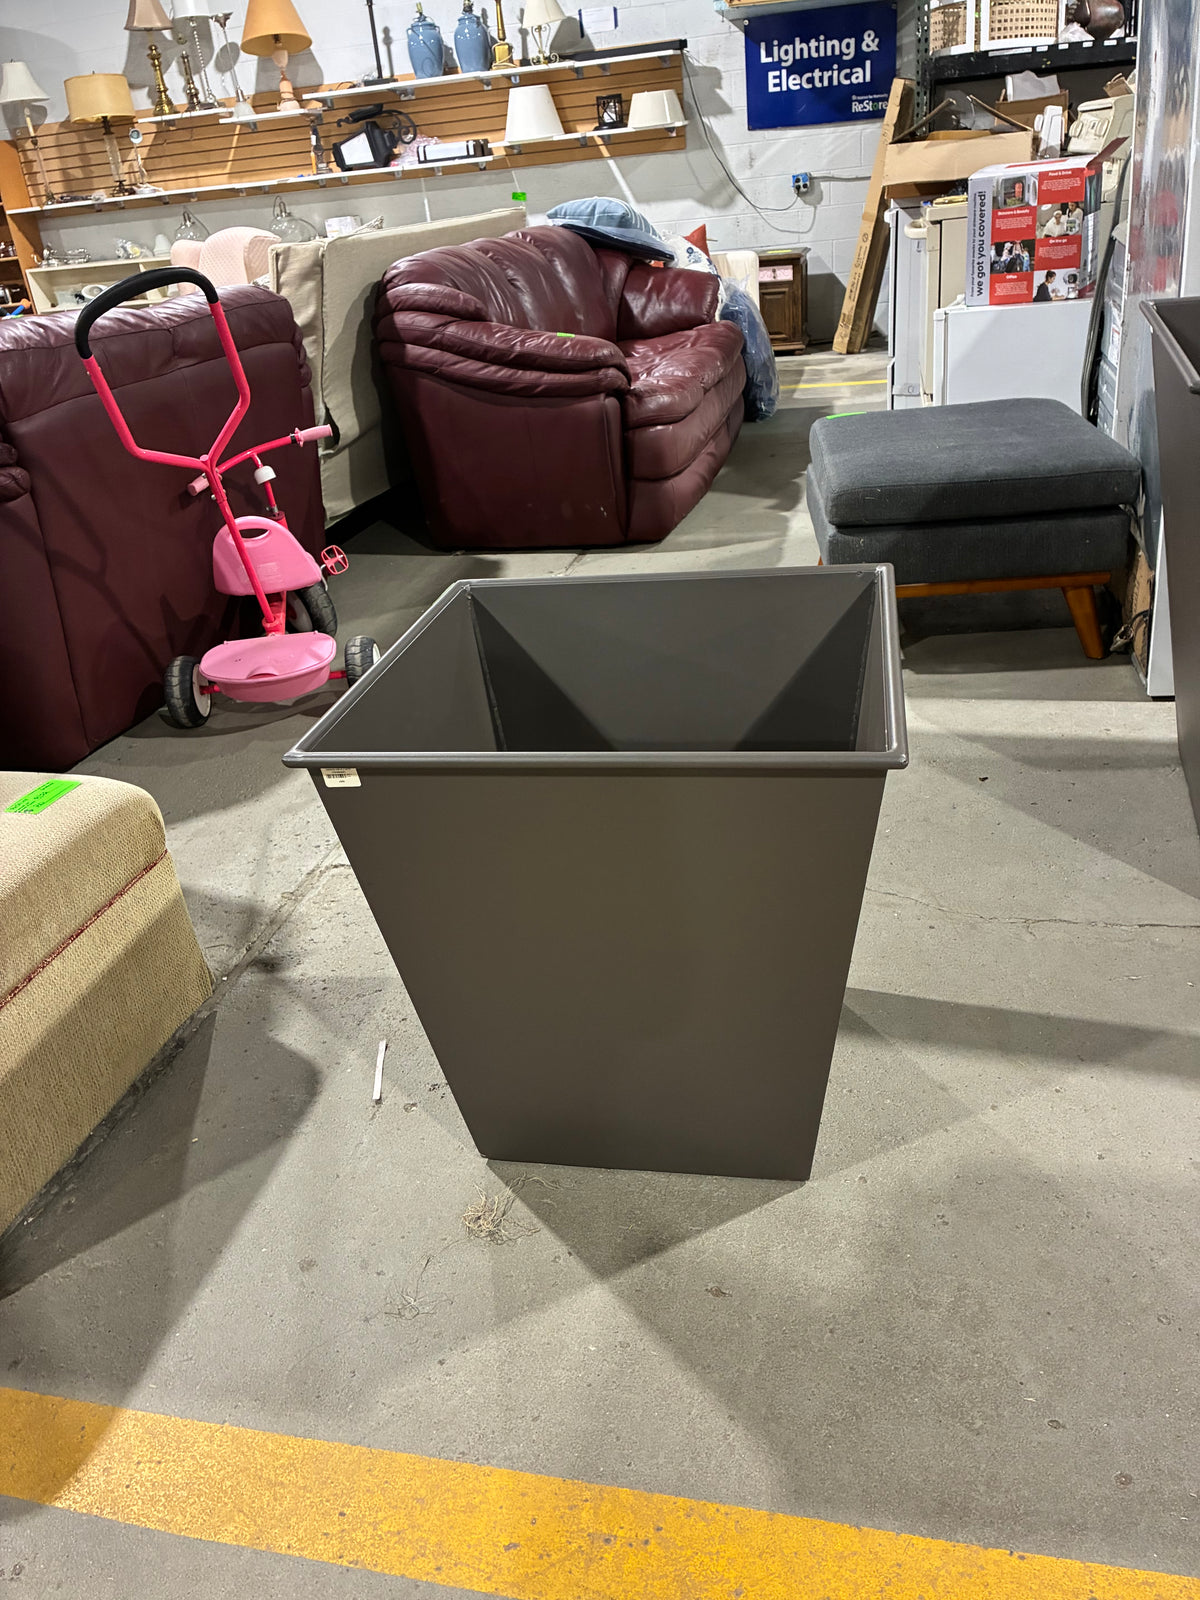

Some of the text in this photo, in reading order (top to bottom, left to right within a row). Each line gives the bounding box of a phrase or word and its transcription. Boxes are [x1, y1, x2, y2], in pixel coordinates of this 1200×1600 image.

[760, 30, 880, 67] Lighting &
[767, 60, 872, 93] Electrical
[852, 100, 889, 113] ReStore
[976, 190, 987, 297] we got you covered!
